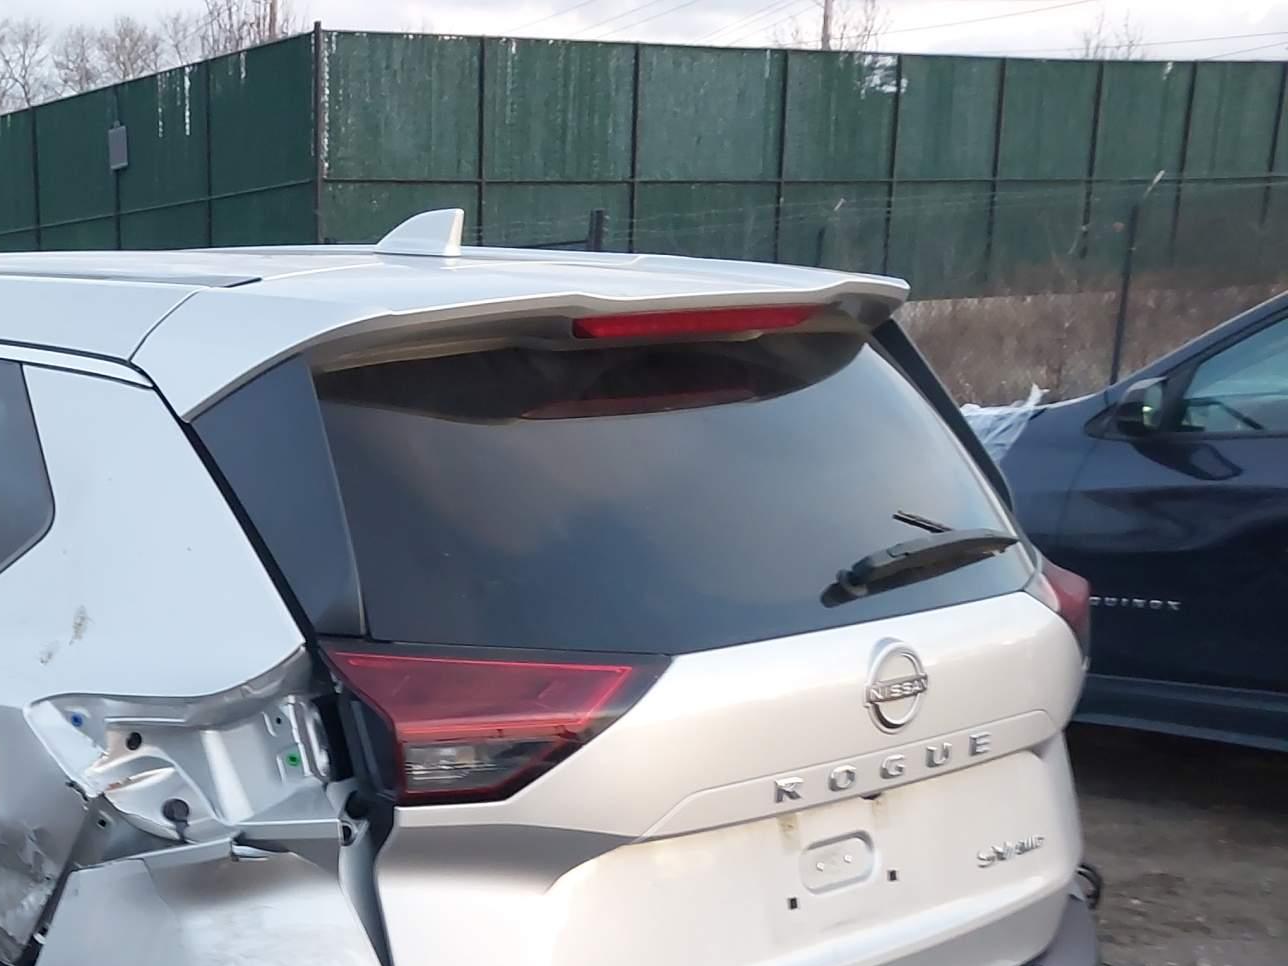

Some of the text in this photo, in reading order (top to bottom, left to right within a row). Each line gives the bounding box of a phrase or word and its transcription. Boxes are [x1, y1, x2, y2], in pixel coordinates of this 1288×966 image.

[1088, 596, 1182, 611] QUINOX
[869, 677, 926, 700] NISSAN
[774, 732, 993, 803] ROGUE
